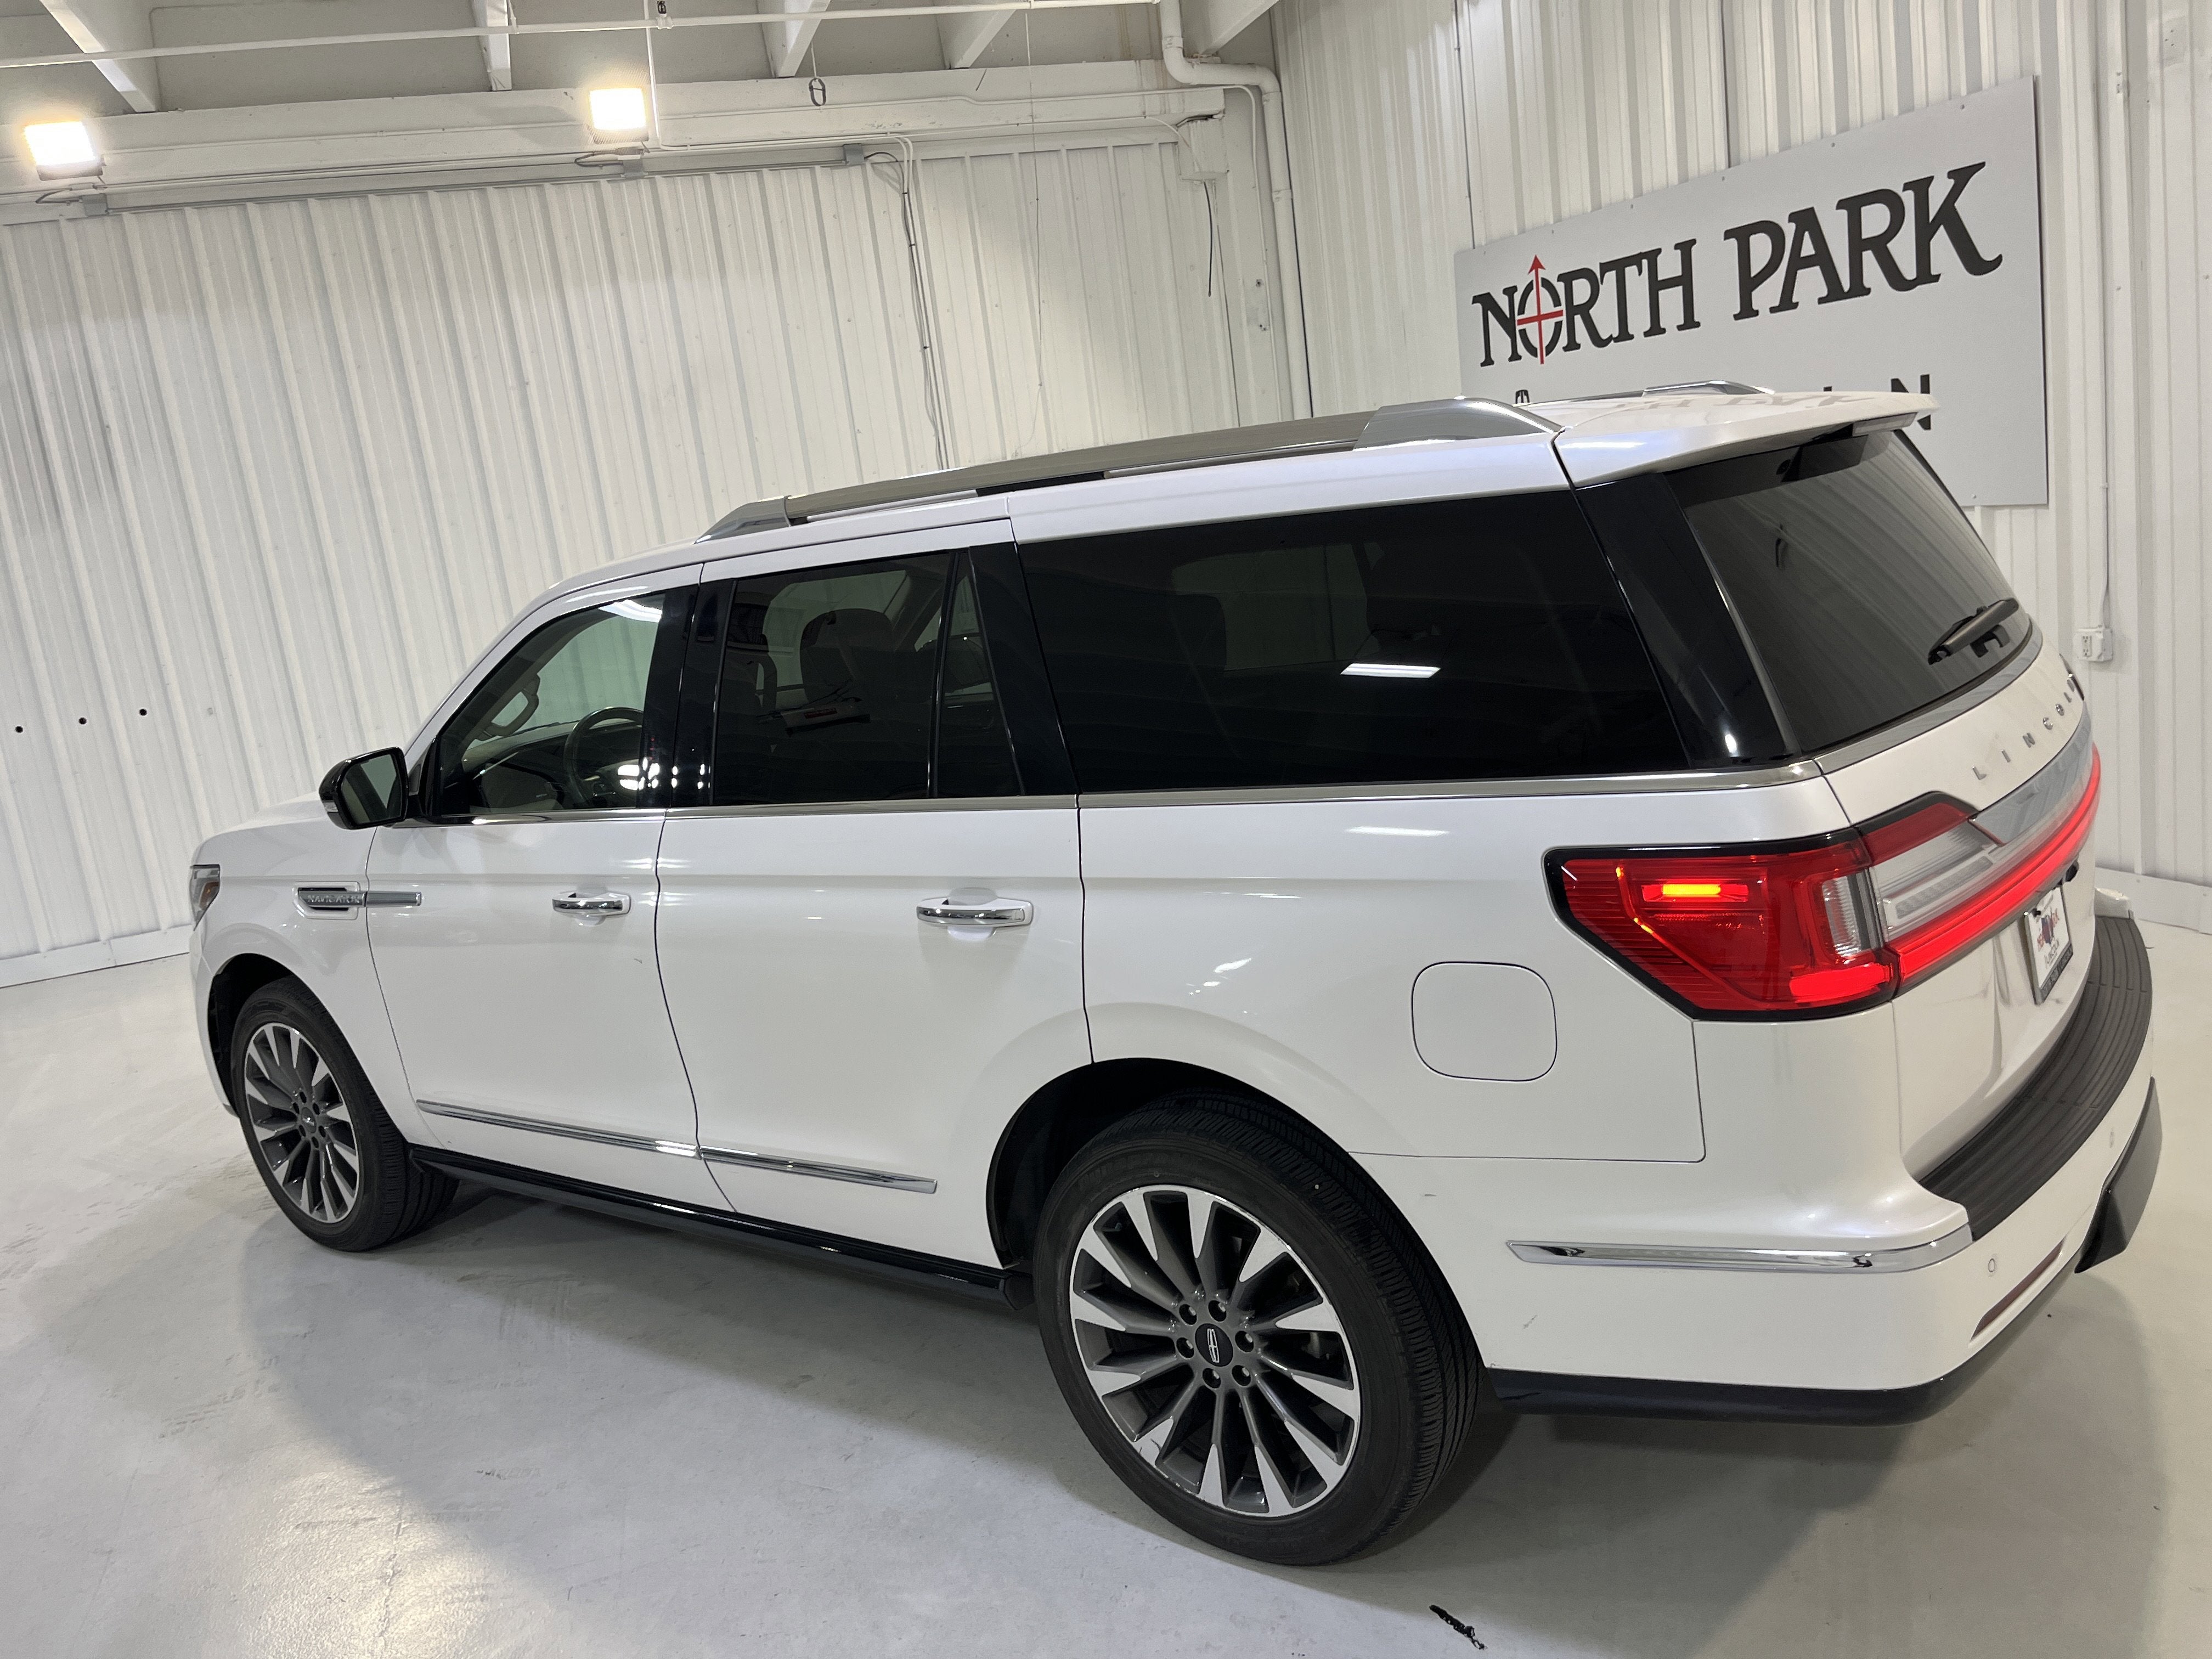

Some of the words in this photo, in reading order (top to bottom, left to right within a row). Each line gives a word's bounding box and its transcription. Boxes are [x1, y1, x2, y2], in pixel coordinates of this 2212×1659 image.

[1472, 238, 1701, 366] NORTH
[1724, 161, 2003, 321] PARK
[1972, 679, 2075, 780] LINCOLN
[307, 894, 360, 904] NAVIGATOR
